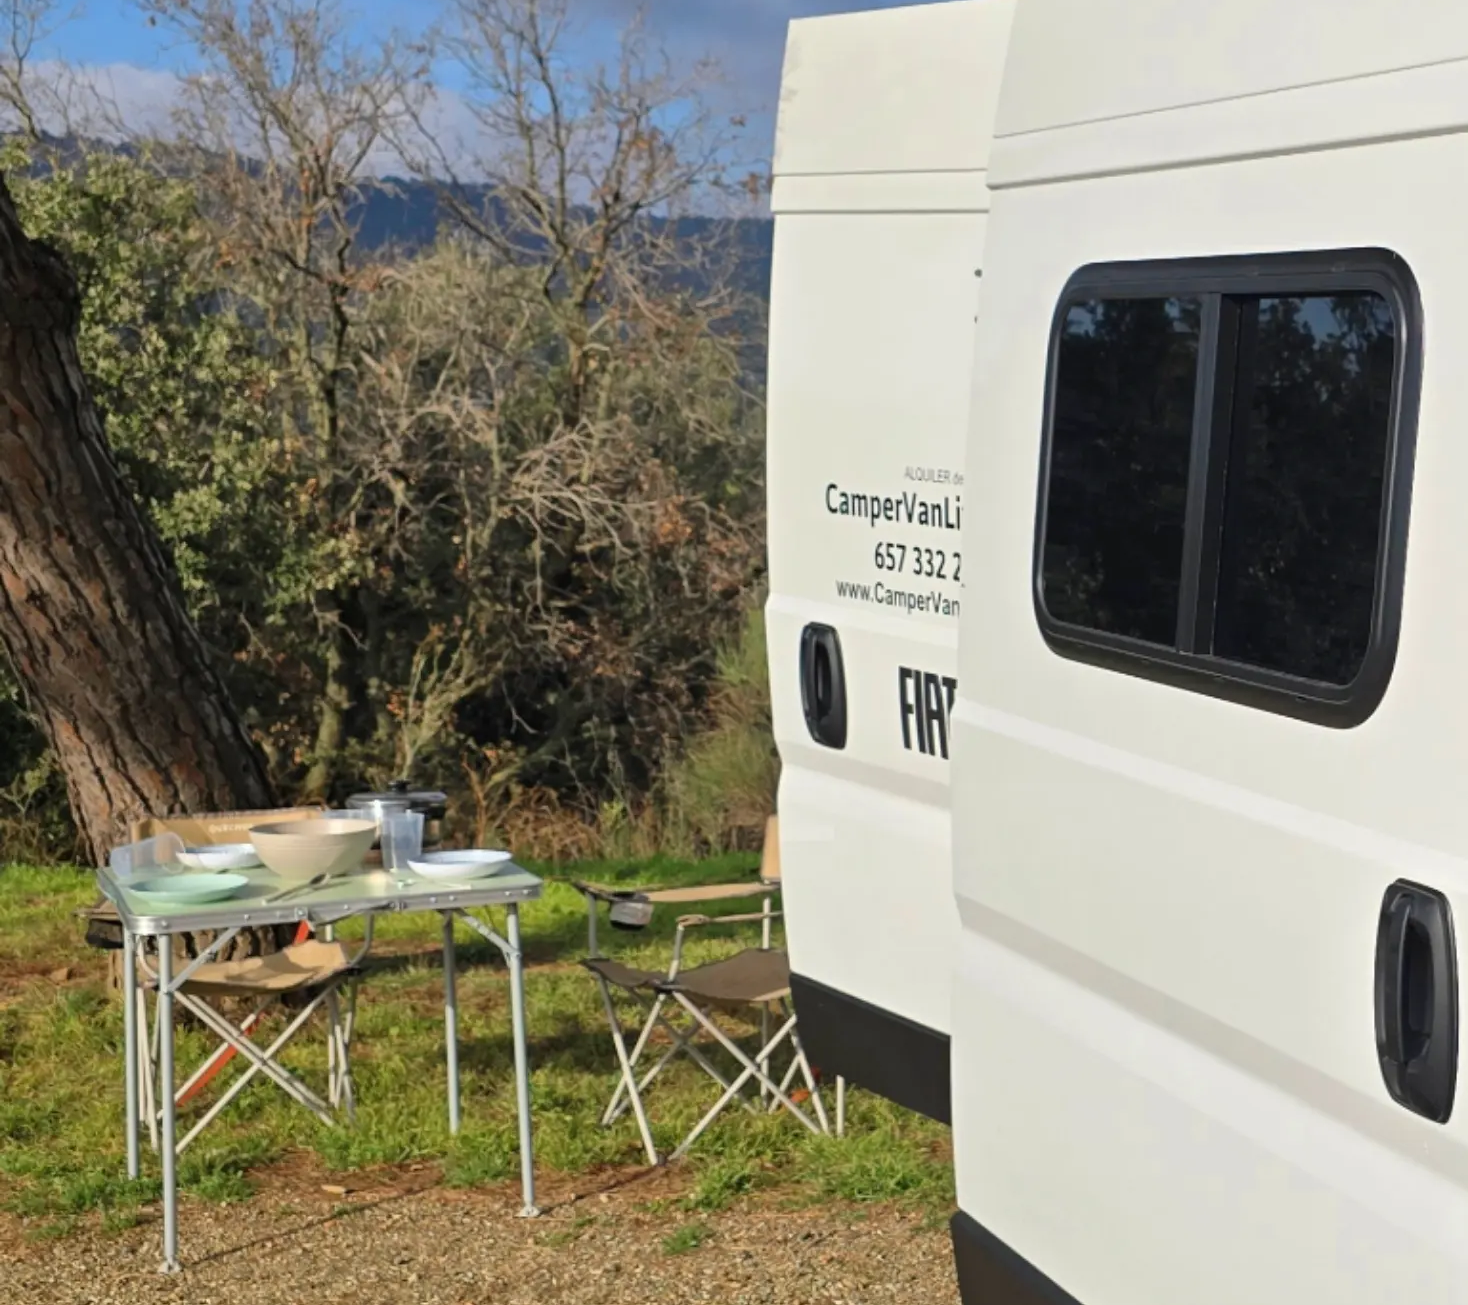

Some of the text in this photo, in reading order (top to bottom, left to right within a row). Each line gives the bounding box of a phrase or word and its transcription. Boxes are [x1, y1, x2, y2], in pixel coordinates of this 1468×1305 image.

[825, 483, 963, 531] CamperVanLi
[874, 541, 907, 573] 657
[912, 546, 947, 580] 332
[836, 579, 961, 619] www.CamperVan
[898, 665, 958, 761] FIAT
